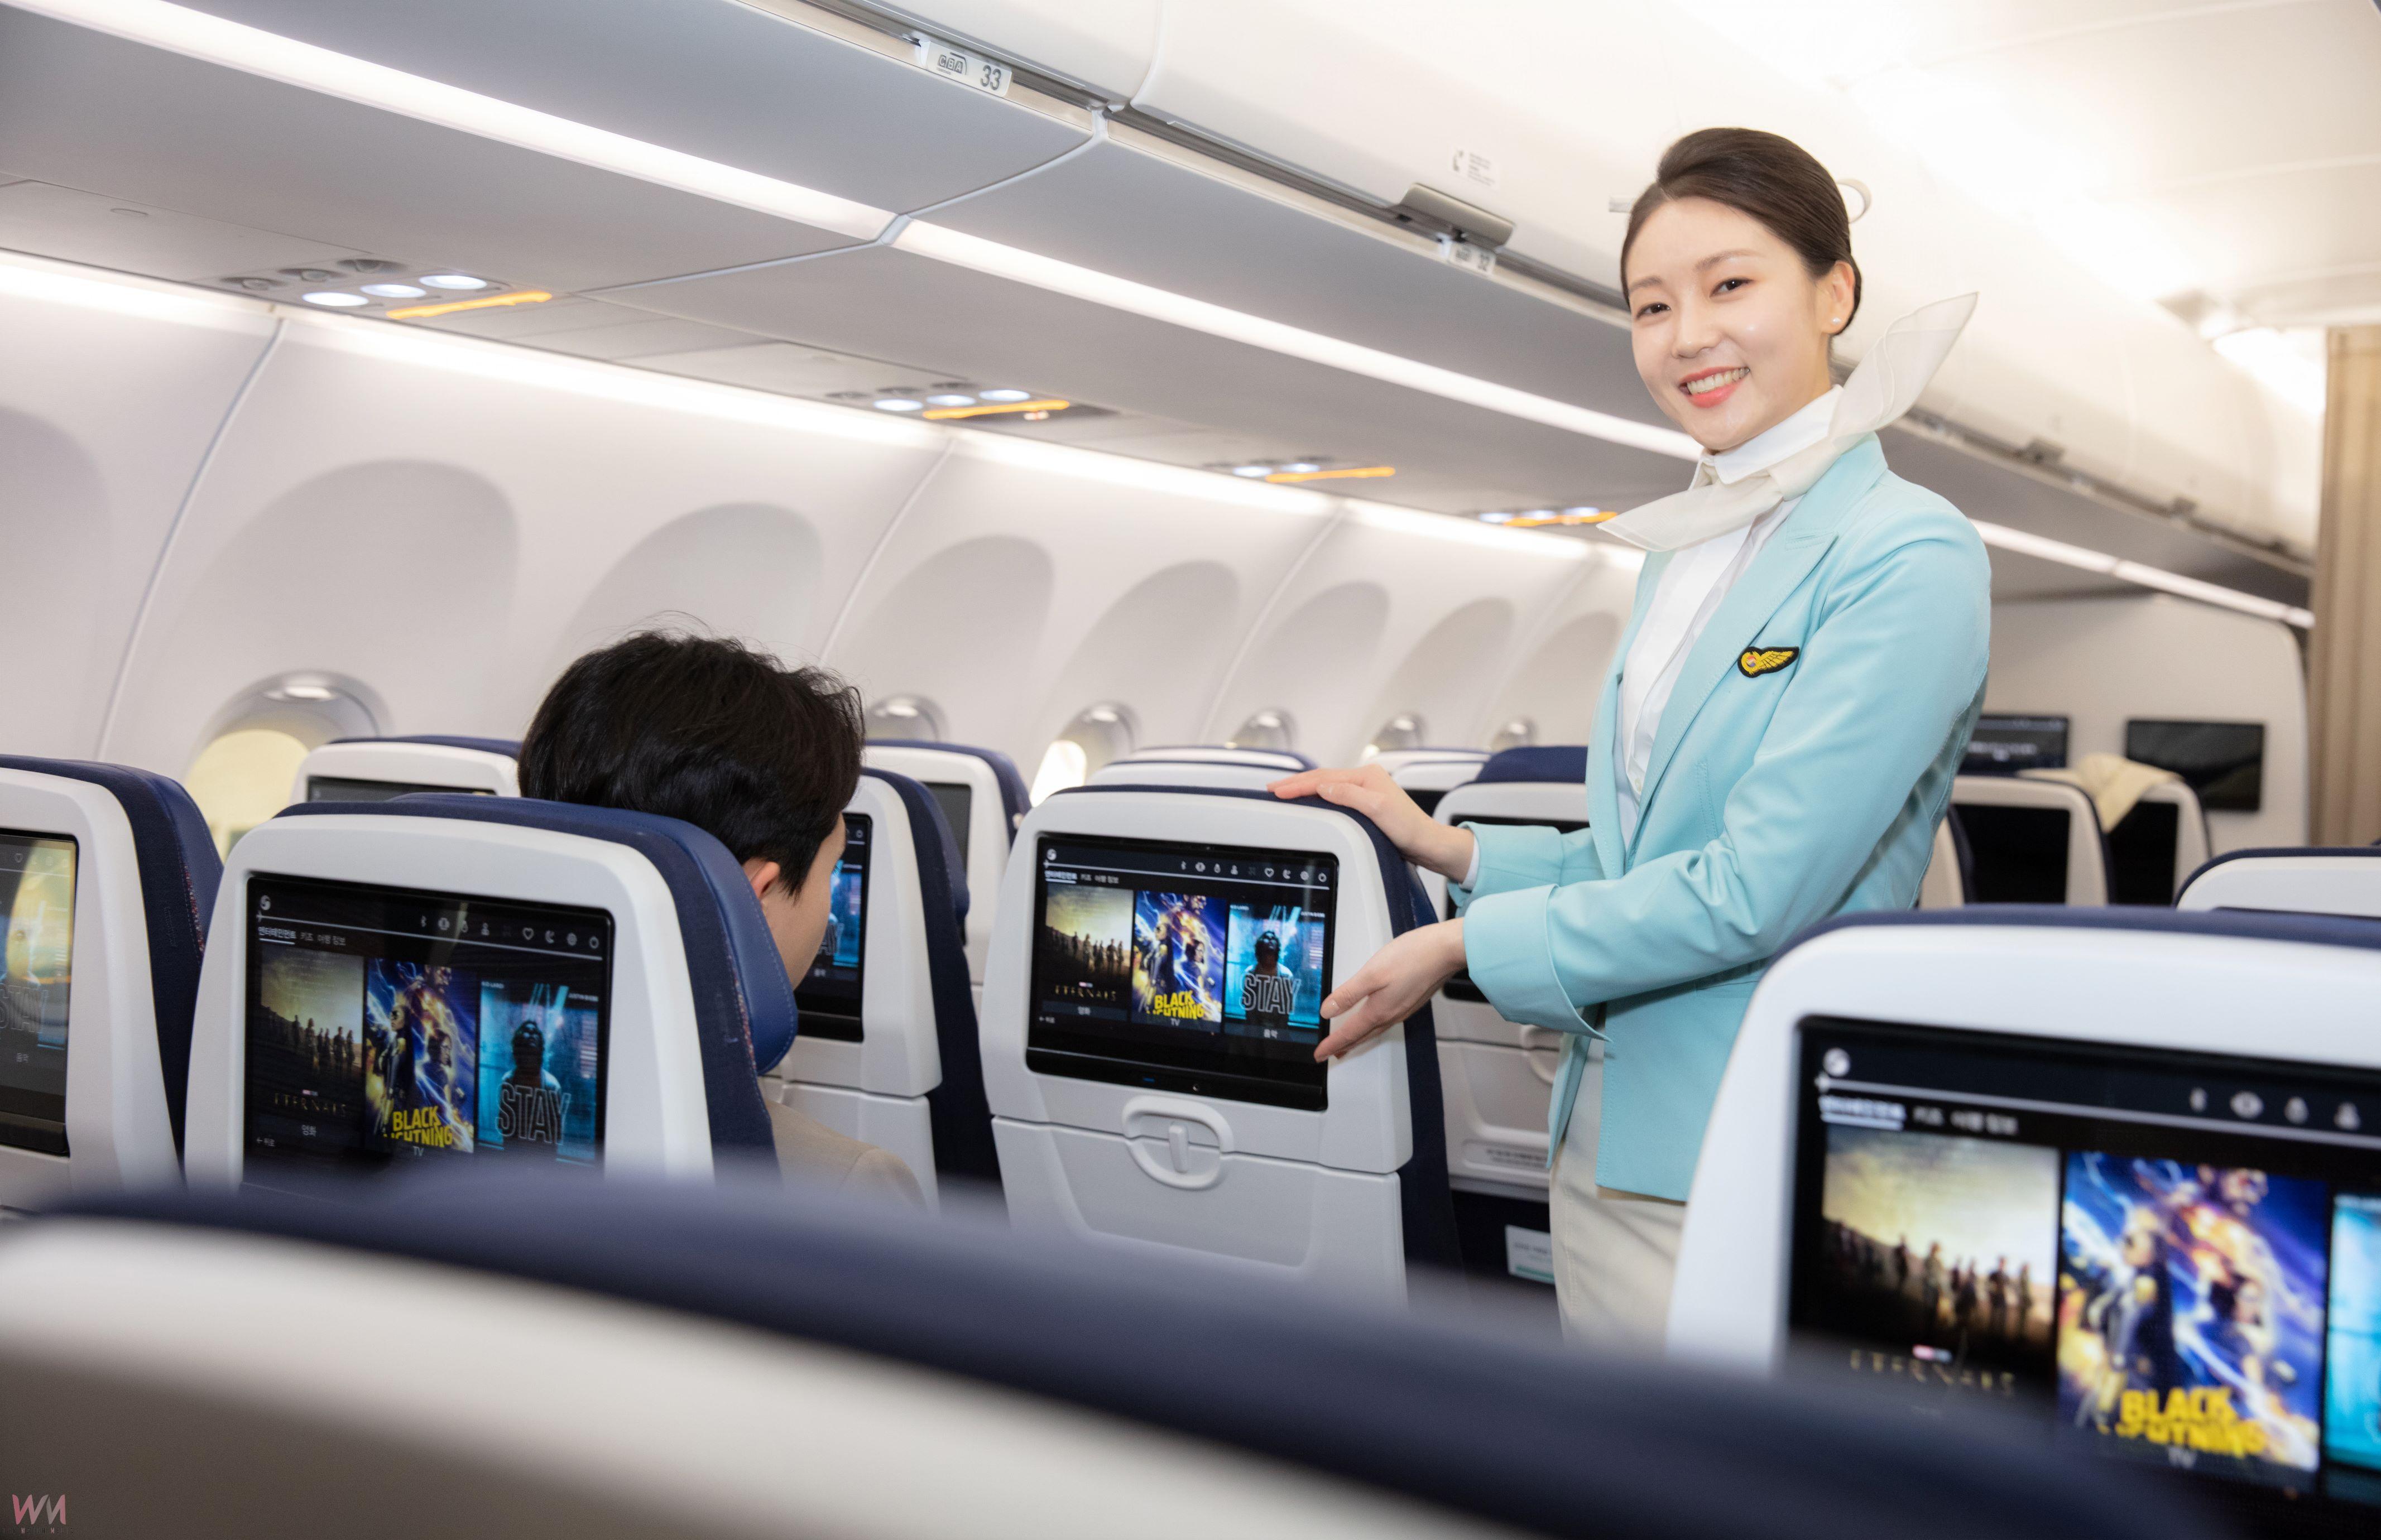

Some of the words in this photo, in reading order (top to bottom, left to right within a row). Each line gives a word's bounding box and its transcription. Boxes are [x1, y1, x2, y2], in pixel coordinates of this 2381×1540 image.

[980, 65, 1001, 90] 33
[1154, 990, 1196, 1009] BLACK
[1239, 973, 1302, 1015] STAY
[1170, 1017, 1181, 1027] TV
[392, 1105, 441, 1132] BLACK
[495, 1081, 572, 1146] STAY
[301, 1124, 318, 1137] 영화
[383, 1125, 453, 1148] HTNING
[412, 1146, 425, 1157] TV
[2120, 1386, 2238, 1424] BLACK
